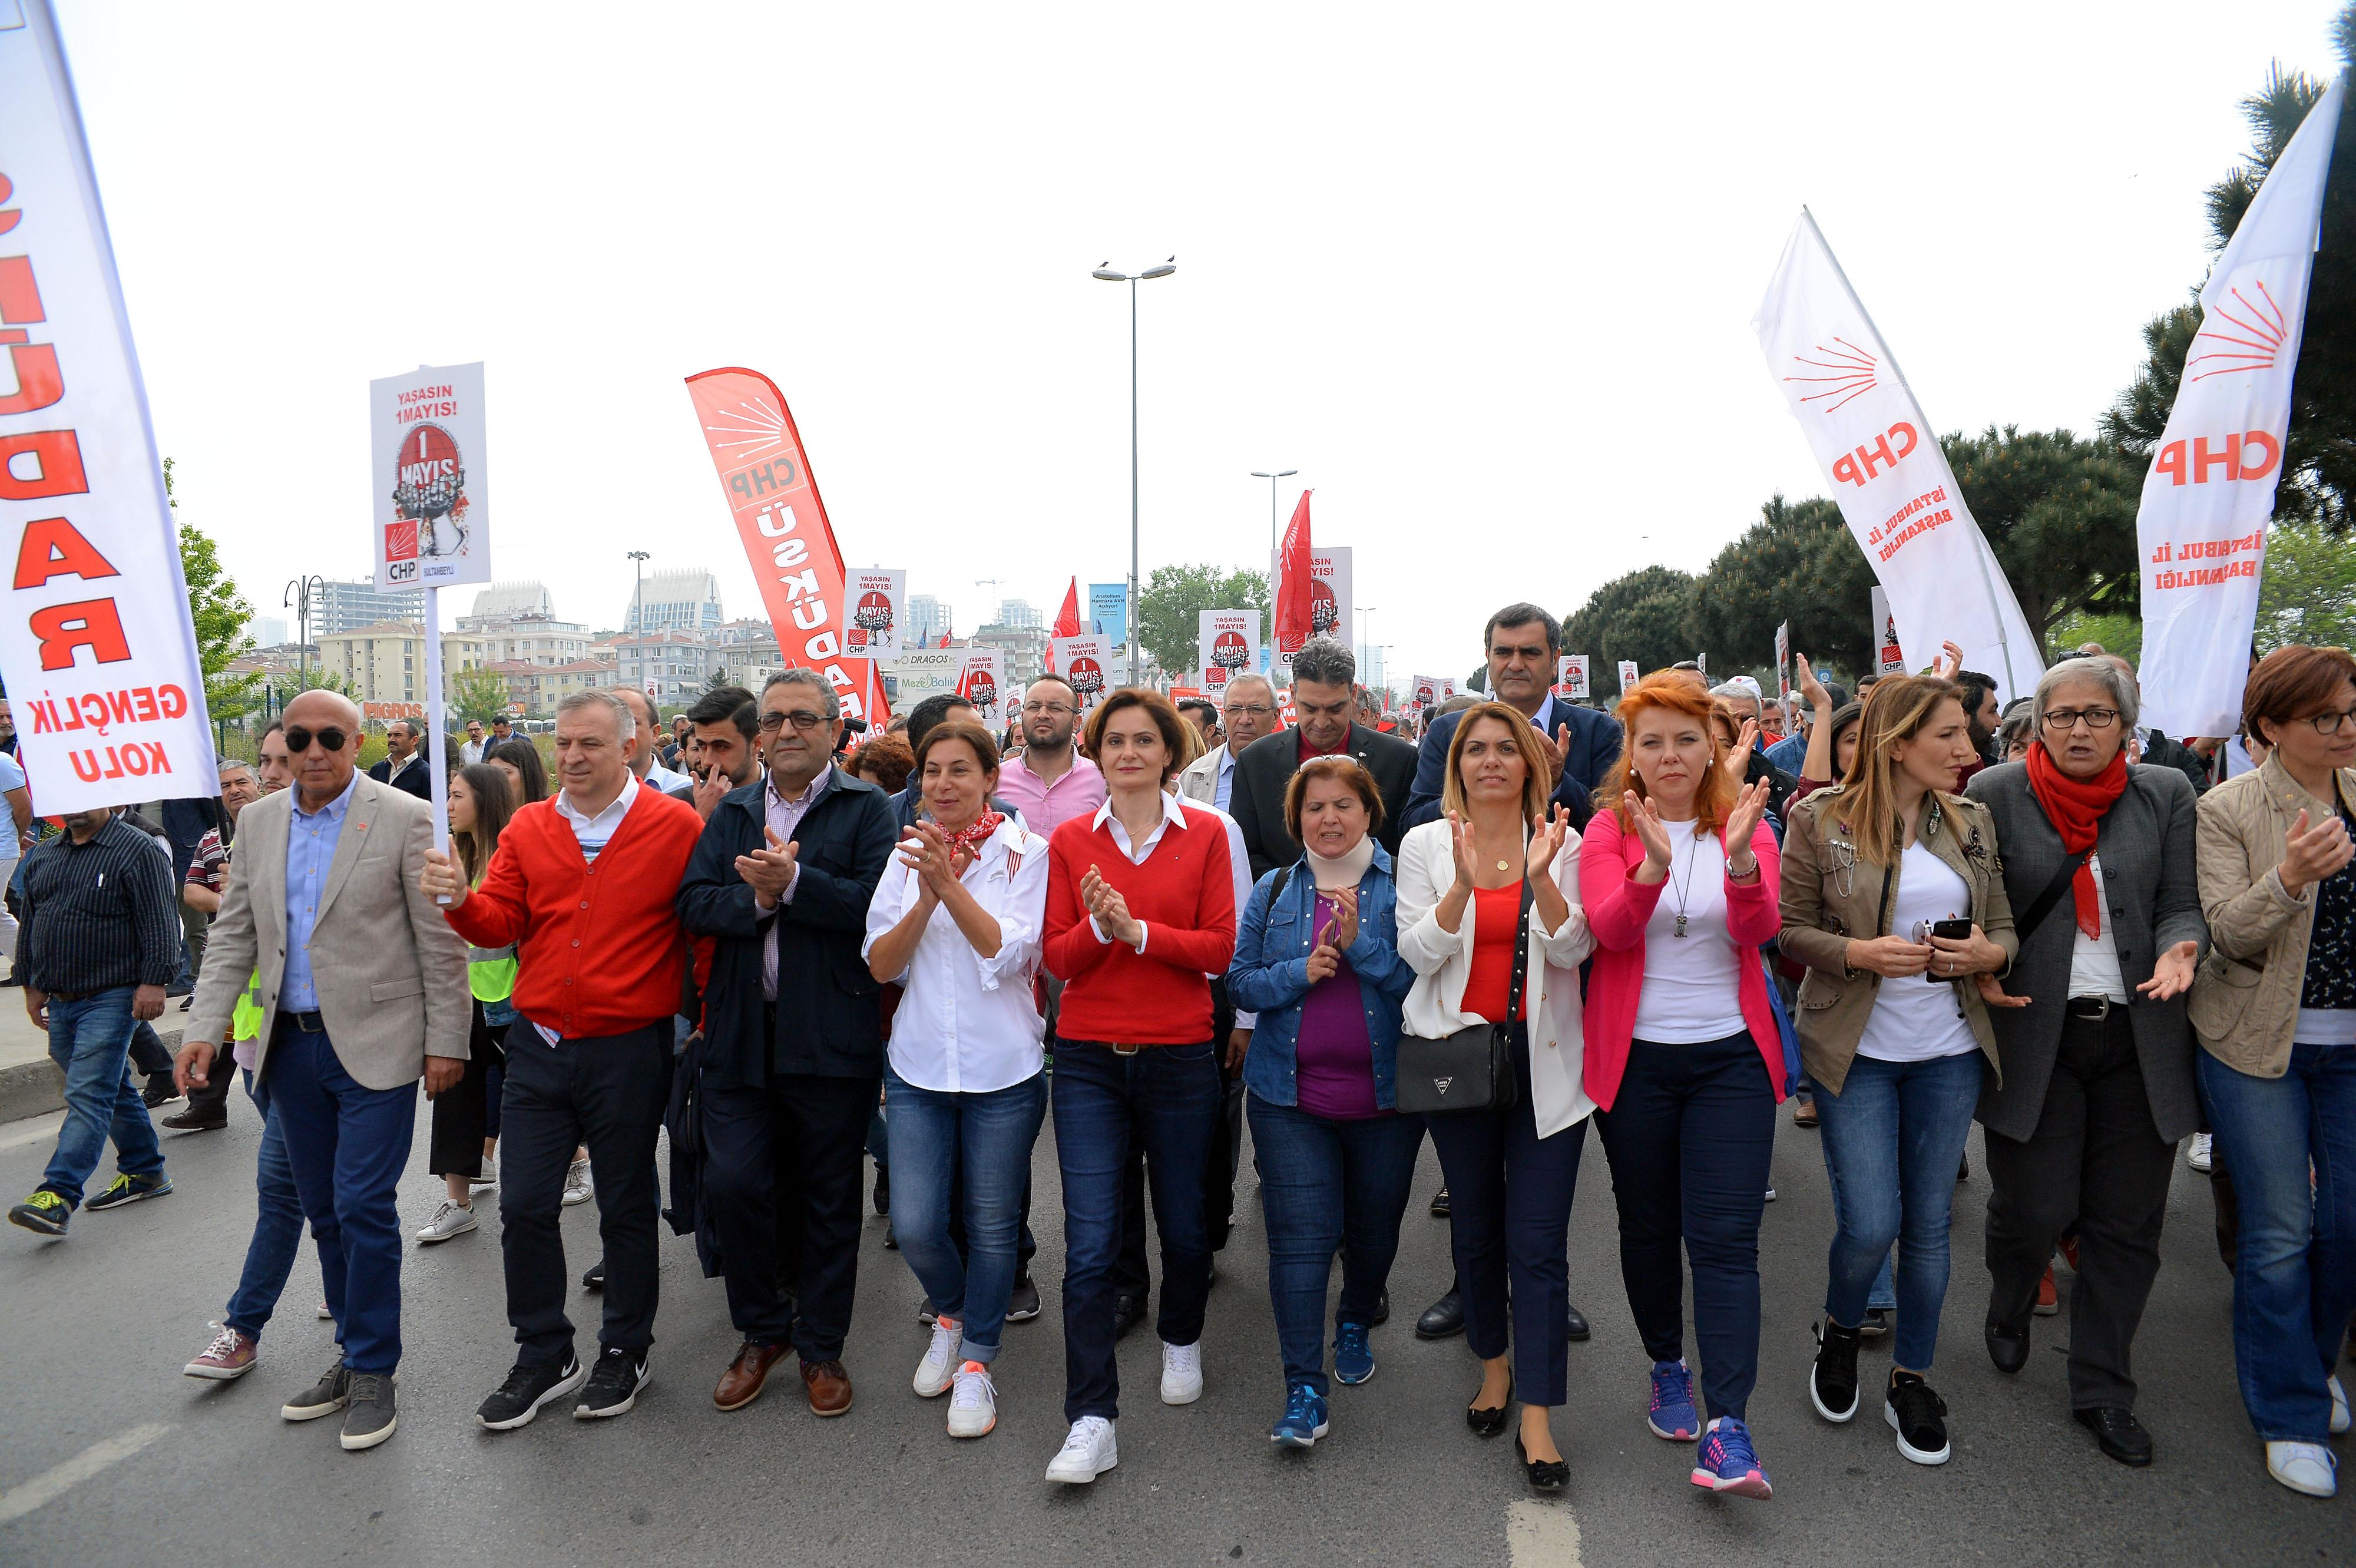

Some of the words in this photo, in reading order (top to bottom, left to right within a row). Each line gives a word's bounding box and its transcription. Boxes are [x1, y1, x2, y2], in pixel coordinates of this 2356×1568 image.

[397, 385, 452, 405] YAŞASIN
[396, 401, 458, 424] 1MAYIS!
[419, 431, 427, 458] 1
[401, 458, 454, 487] MAYIS
[389, 561, 415, 580] CHP
[1311, 567, 1333, 576] YIS!
[872, 594, 876, 606] 1
[860, 606, 888, 616] MAYIS
[1312, 599, 1331, 613] YIS
[1228, 634, 1232, 645] 1
[1067, 649, 1098, 657] 1MAYIS!
[1216, 646, 1245, 655] MAYIS
[911, 655, 948, 664] DRAGOS
[1282, 653, 1296, 663] CH
[1081, 660, 1086, 671] 1
[1884, 662, 1901, 671] CHP
[978, 673, 982, 683] 1
[1072, 670, 1098, 681] MAYIS
[902, 678, 925, 688] Meze
[932, 677, 955, 687] Balık
[971, 684, 992, 693] MAYIS
